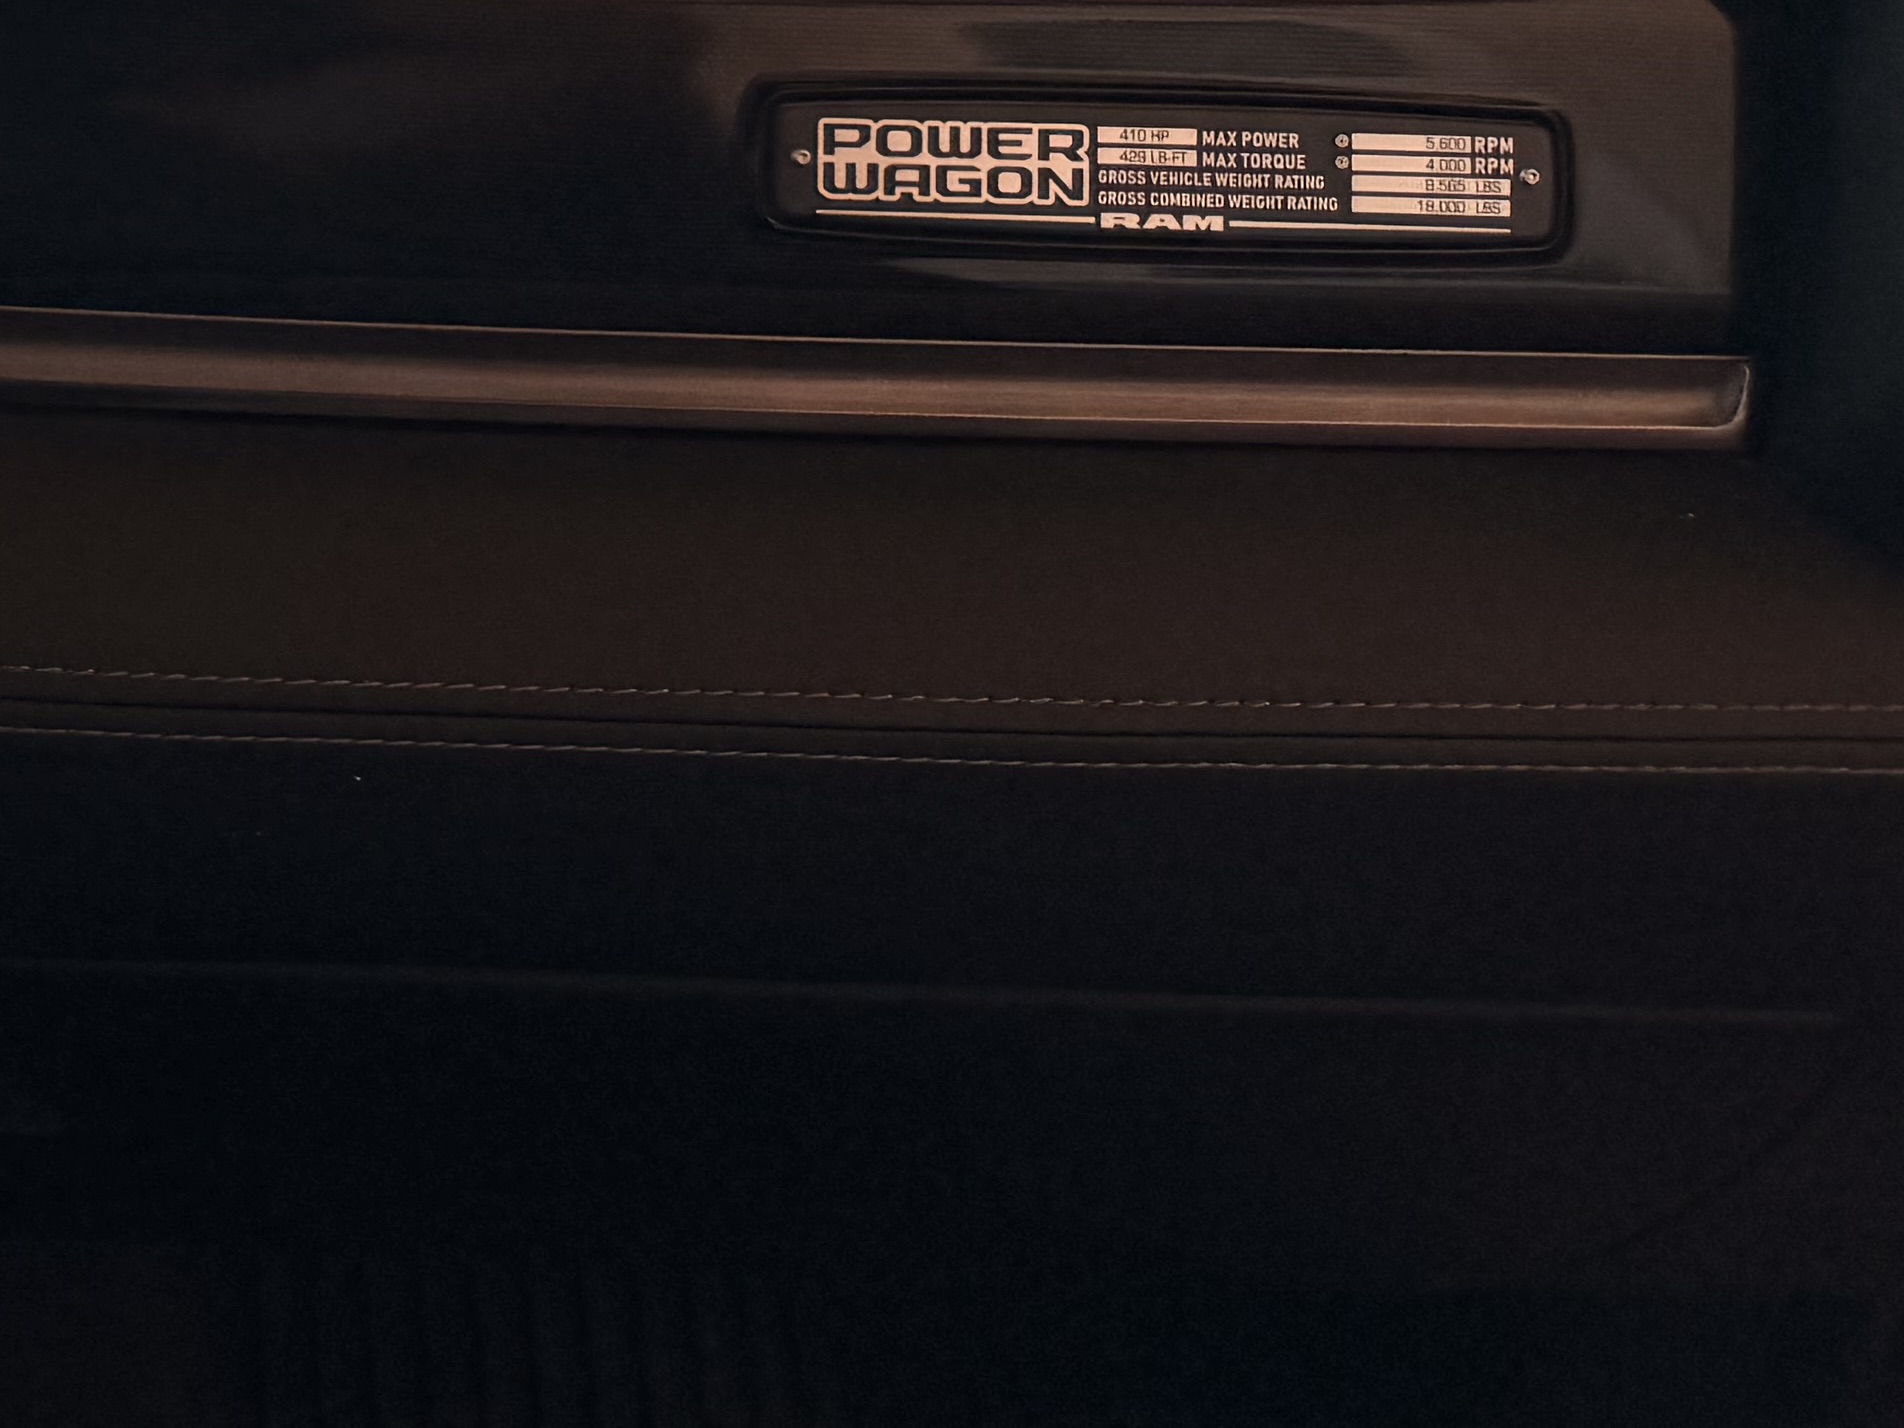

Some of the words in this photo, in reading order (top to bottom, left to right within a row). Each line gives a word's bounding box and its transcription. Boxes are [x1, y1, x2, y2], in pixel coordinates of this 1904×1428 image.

[823, 123, 1085, 162] POWER
[1119, 128, 1147, 142] 410
[1150, 129, 1170, 143] HP
[1202, 130, 1237, 148] MAX
[1242, 131, 1299, 149] POWER
[1474, 136, 1514, 154] RPM
[1202, 151, 1237, 168] MAX
[1240, 152, 1306, 170] TORQUE
[1474, 157, 1514, 175] RPM
[823, 161, 1085, 201] WAGON
[1098, 169, 1147, 186] GROSS
[1149, 170, 1212, 187] VEHICLE
[1215, 172, 1269, 189] WEIGHT
[1275, 173, 1325, 190] RATING
[1476, 180, 1502, 194] LBS
[1098, 190, 1146, 206] GROSS
[1149, 192, 1225, 208] COMBINED
[1228, 194, 1284, 210] WEIGHT
[1287, 195, 1339, 212] RATING
[1100, 212, 1225, 232] RAM
